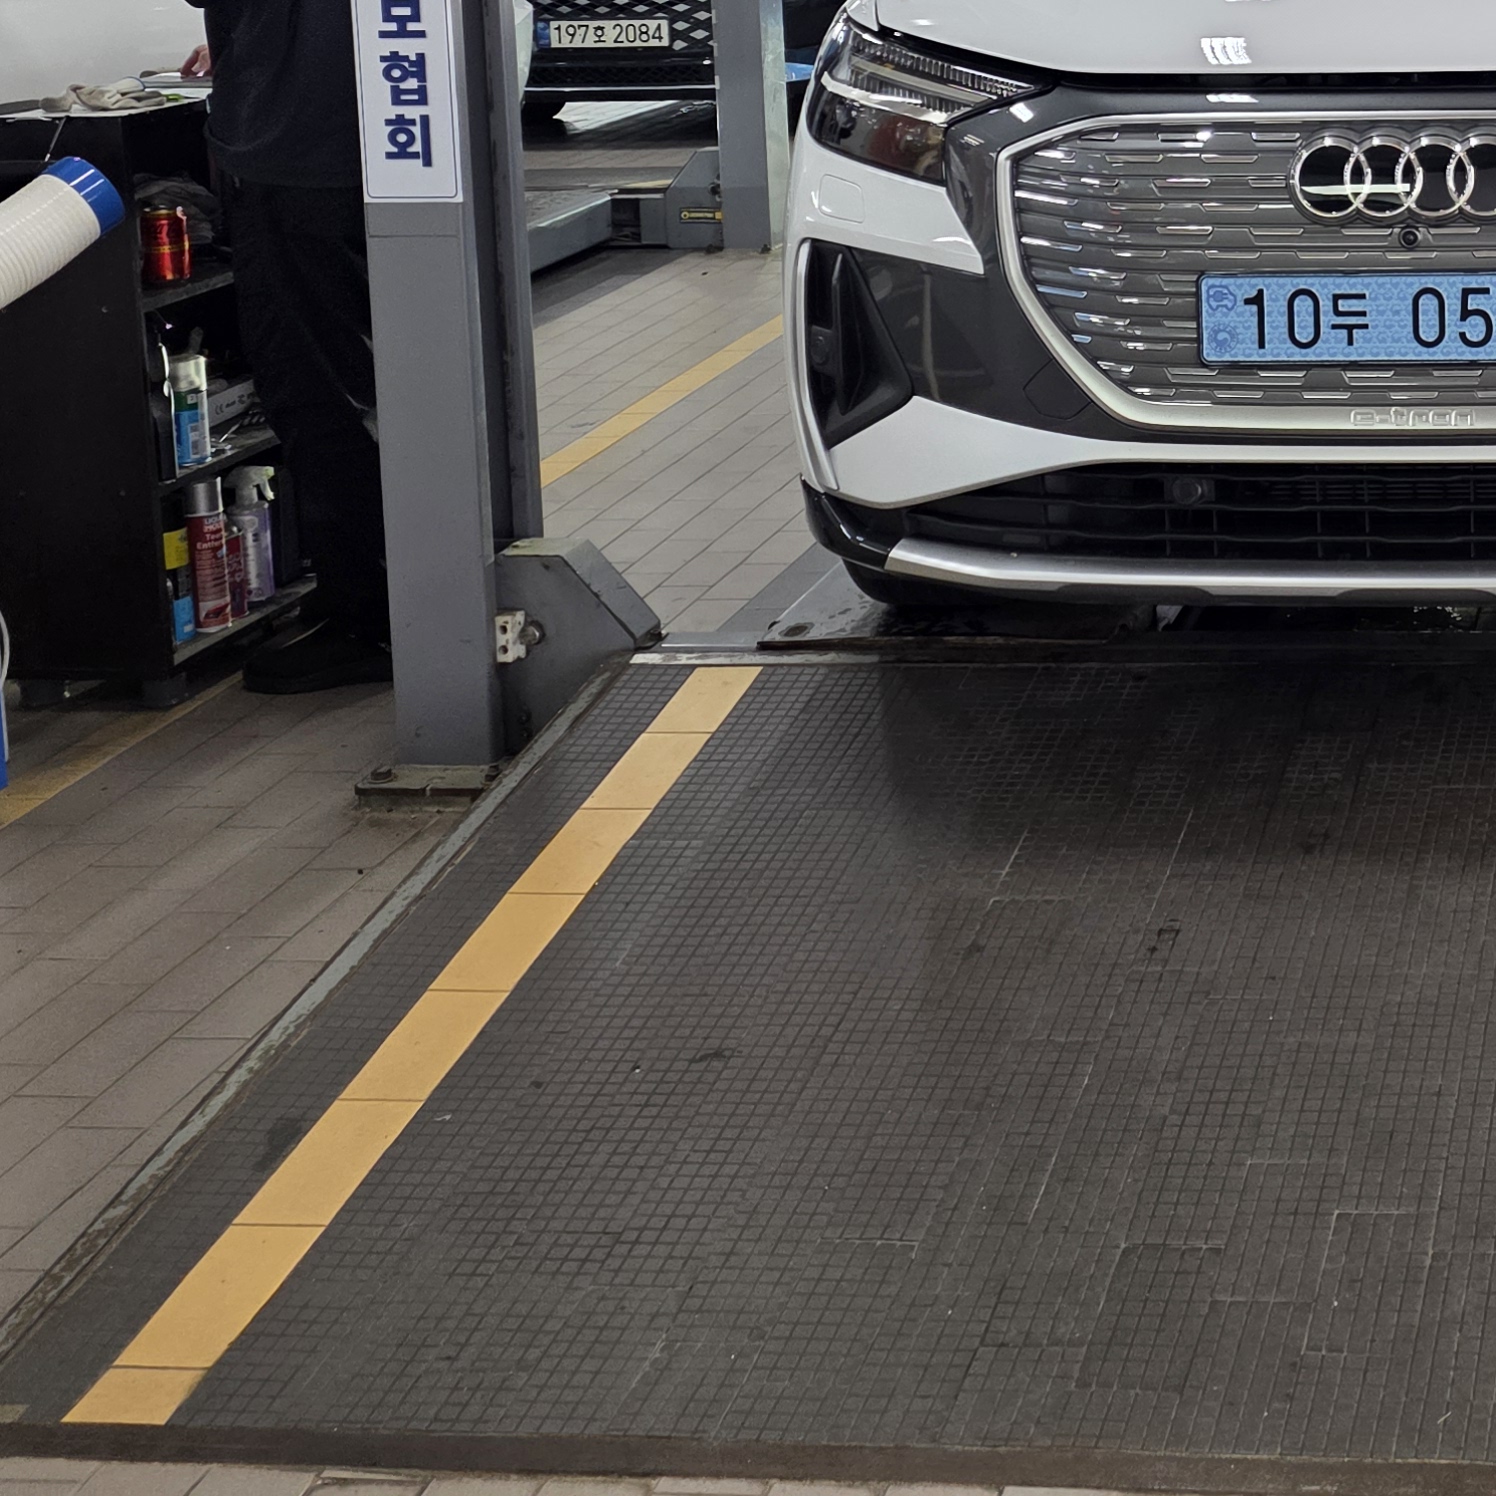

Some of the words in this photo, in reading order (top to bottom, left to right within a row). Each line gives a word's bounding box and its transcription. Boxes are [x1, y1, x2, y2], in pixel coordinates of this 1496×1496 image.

[553, 23, 607, 45] 197호
[612, 22, 664, 44] 2084
[1243, 287, 1369, 350] 10두
[1350, 406, 1476, 427] e-tron
